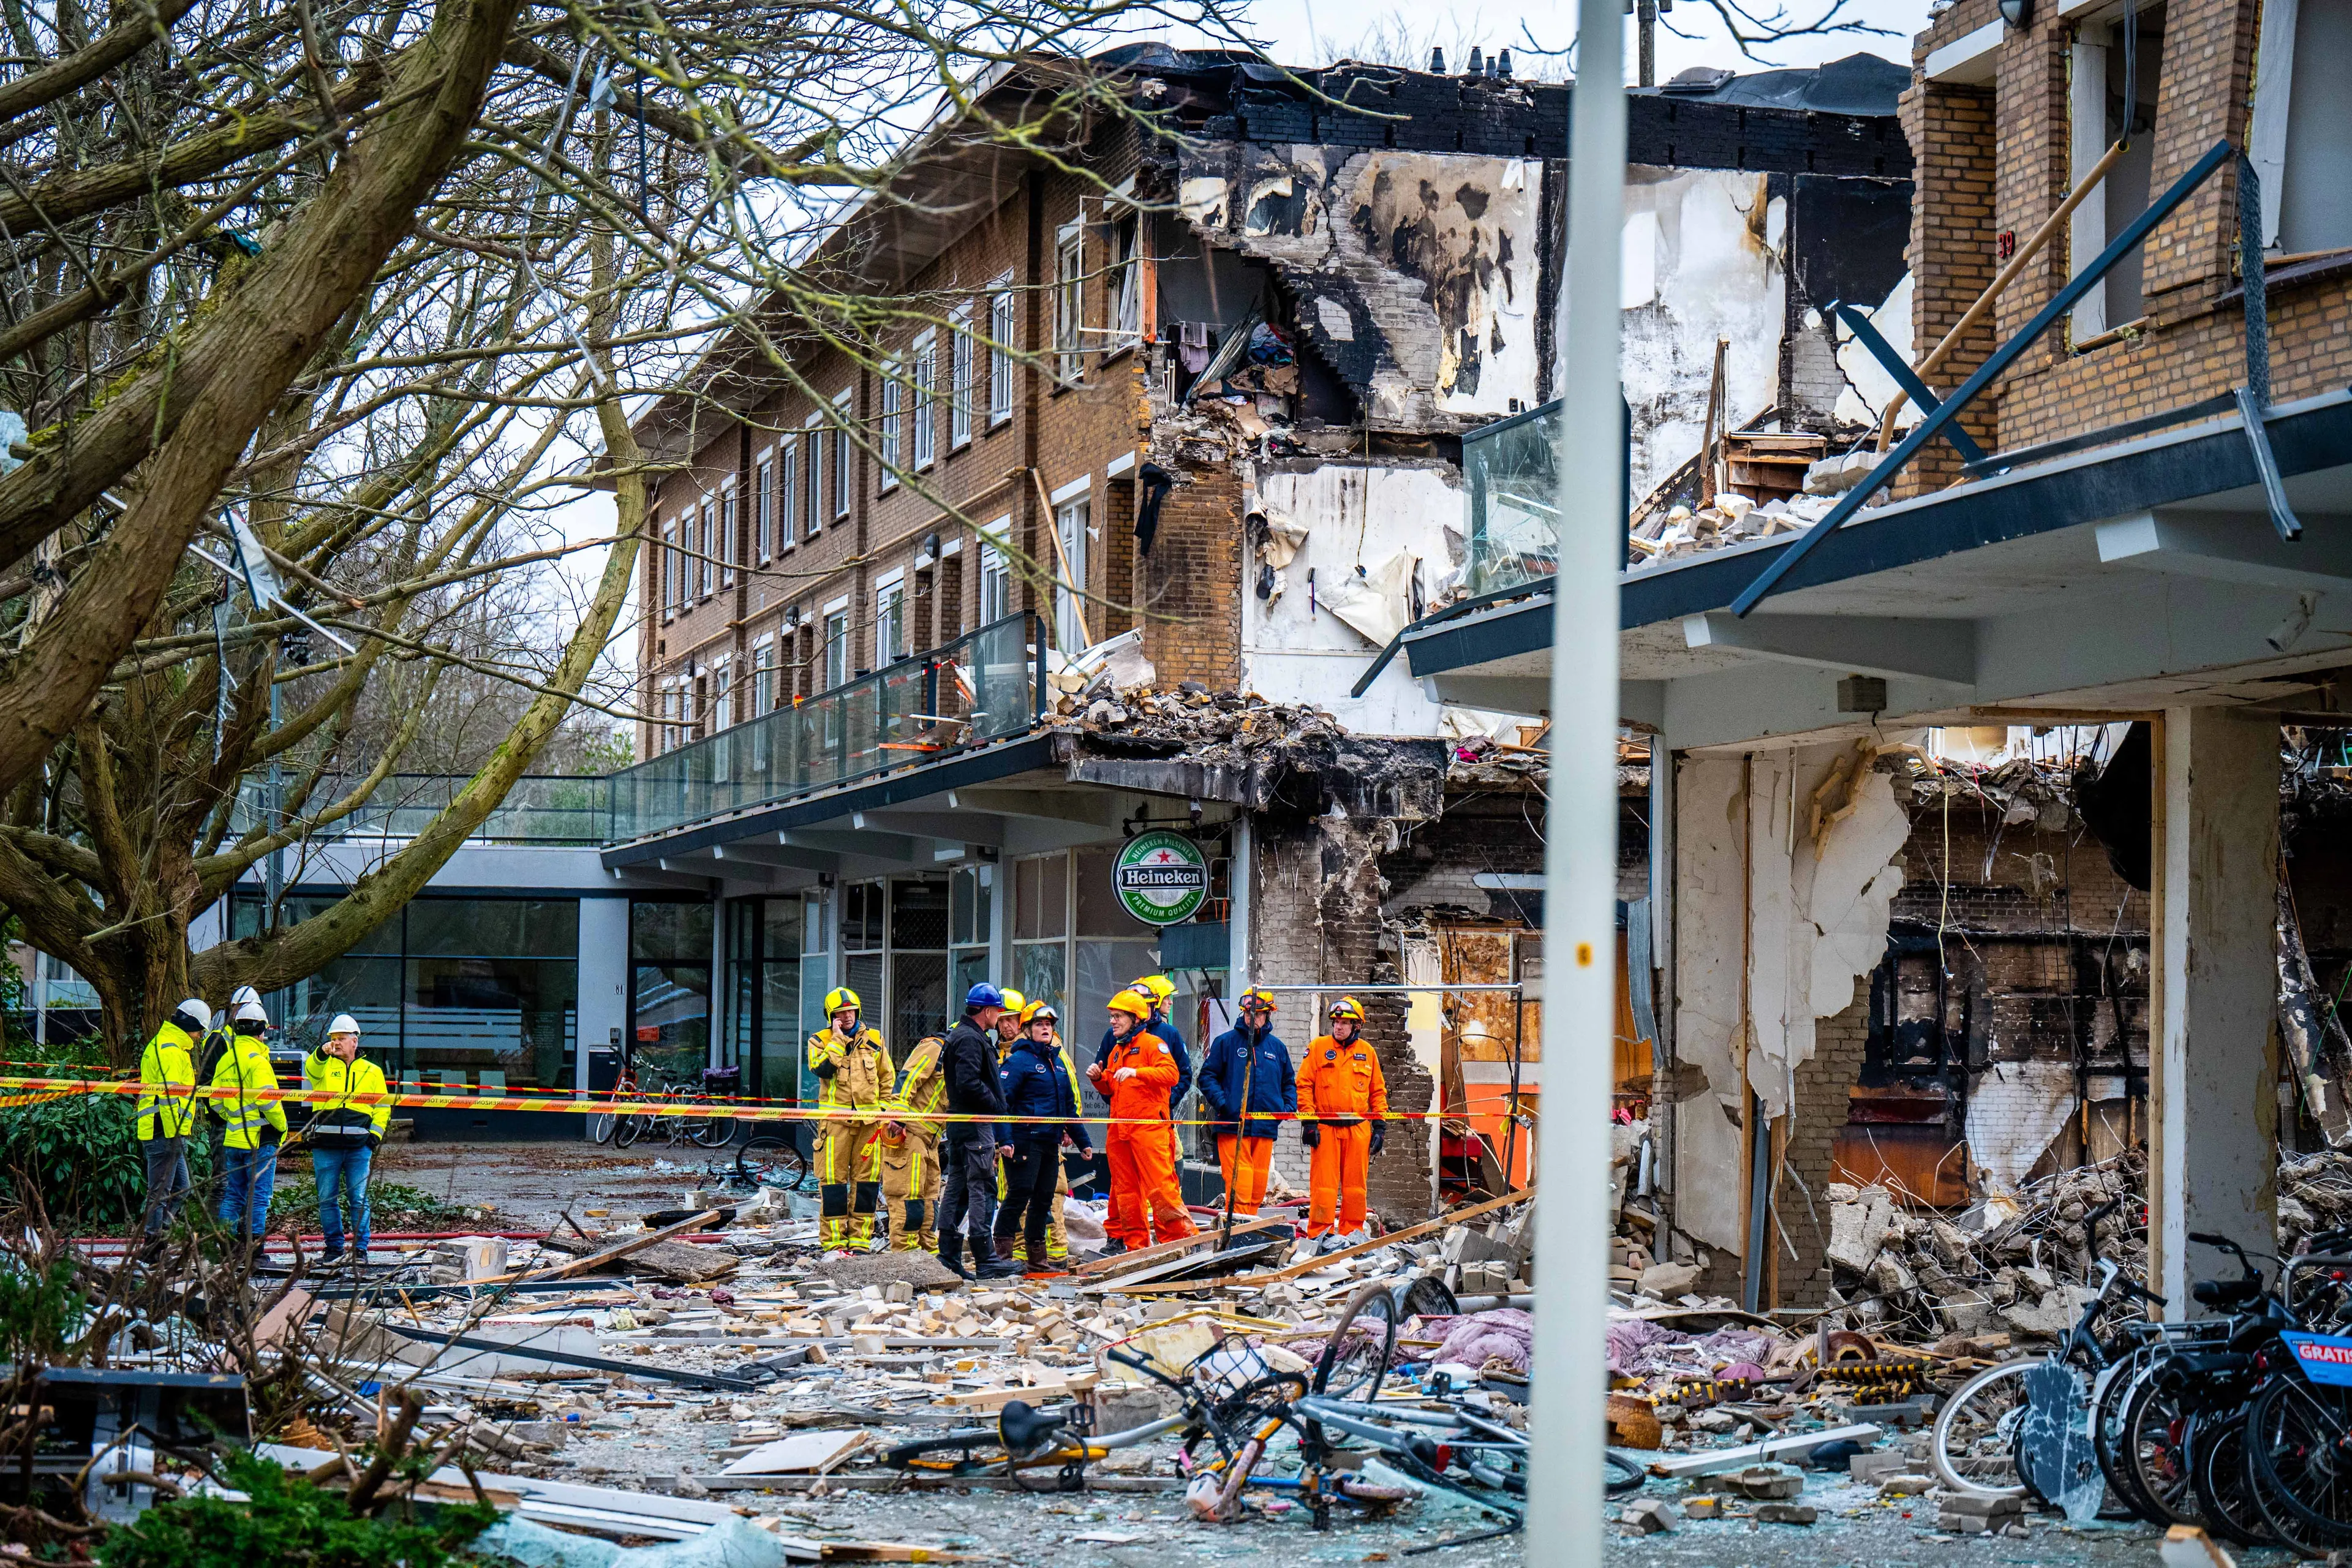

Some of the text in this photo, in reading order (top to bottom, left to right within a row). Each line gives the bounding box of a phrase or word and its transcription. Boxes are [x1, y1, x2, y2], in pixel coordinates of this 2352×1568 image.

[1132, 838, 1193, 859] HEINEKEN PILSENER
[1126, 869, 1200, 884] Heineken
[1132, 895, 1164, 917] PREMIUM
[1167, 894, 1196, 916] QUALITY
[616, 985, 623, 994] 81
[1084, 1091, 1094, 1100] TK
